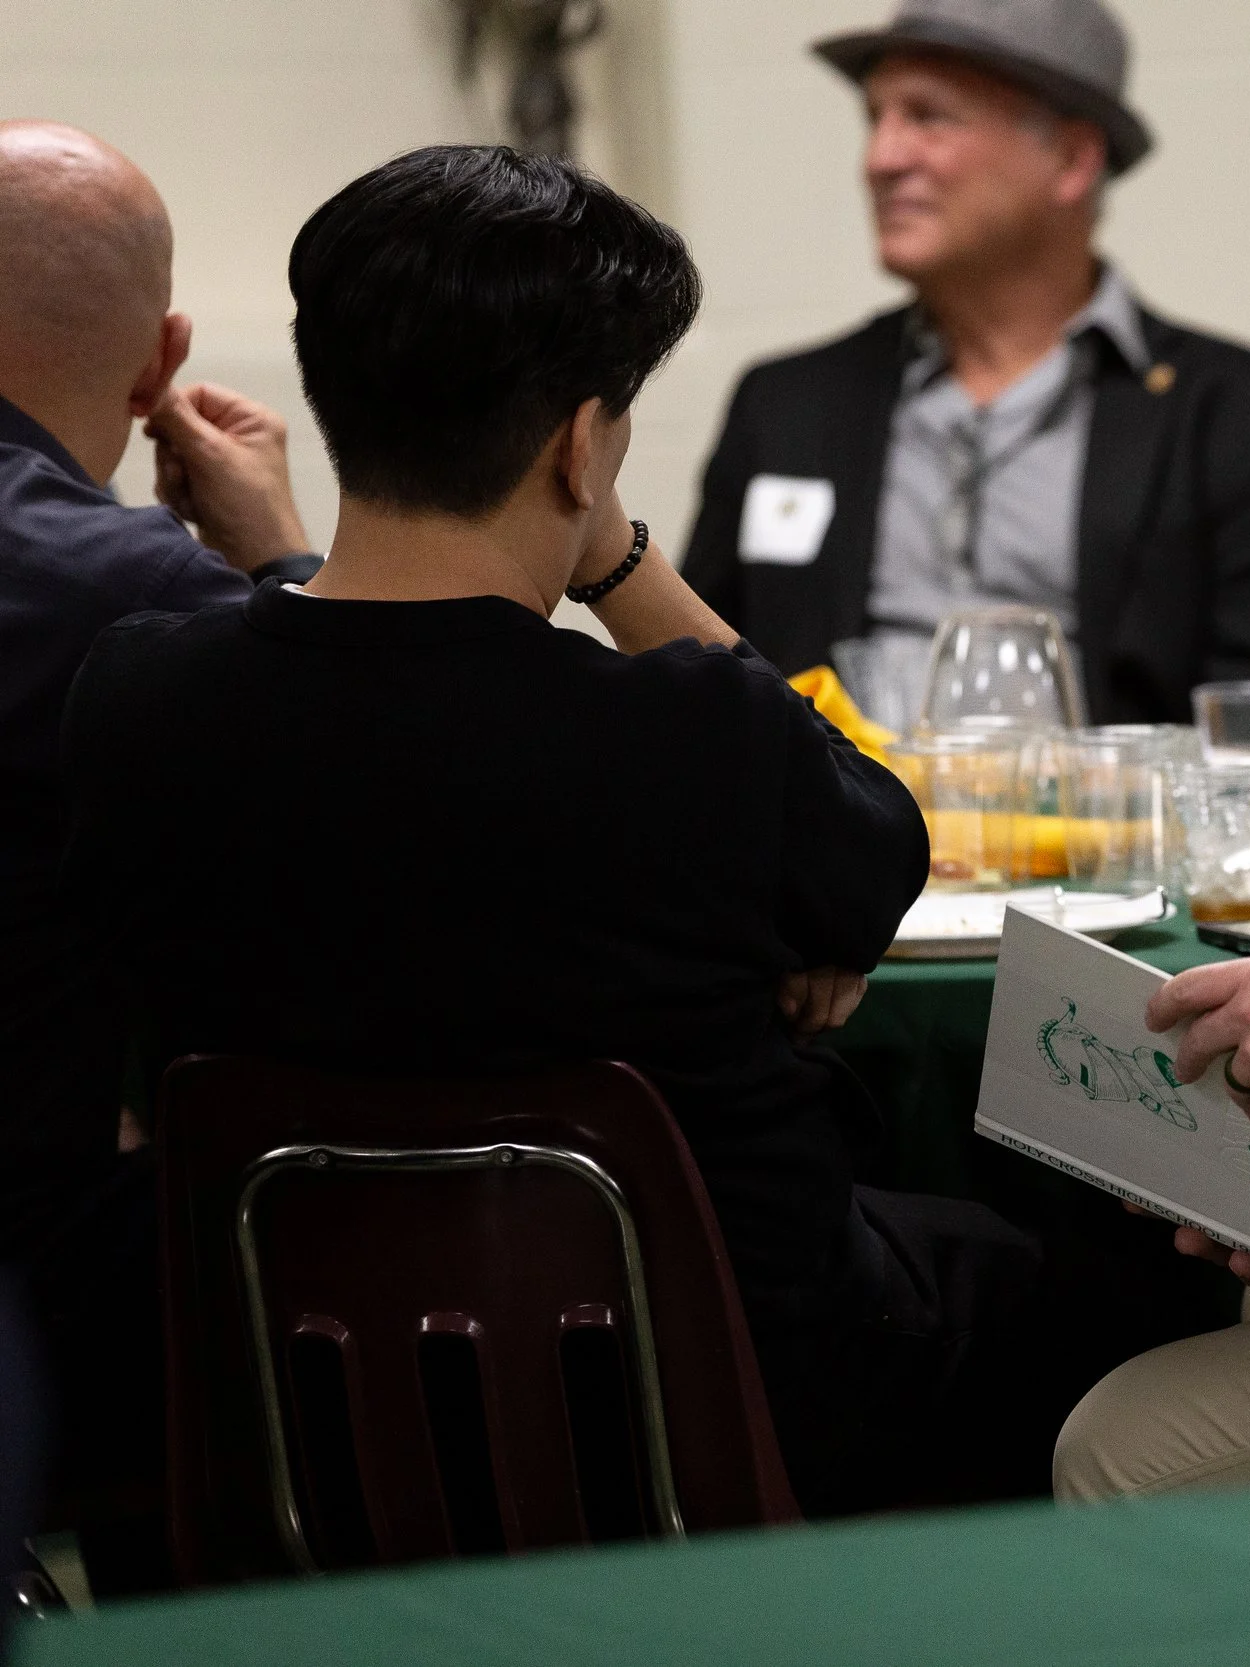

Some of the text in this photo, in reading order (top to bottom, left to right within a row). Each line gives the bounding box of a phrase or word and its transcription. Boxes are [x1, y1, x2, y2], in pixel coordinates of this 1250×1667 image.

[1001, 1133, 1044, 1159] HOLY
[1048, 1155, 1106, 1188] CROSS
[1109, 1184, 1151, 1209] HIGH
[1154, 1203, 1222, 1241] SCHOOL
